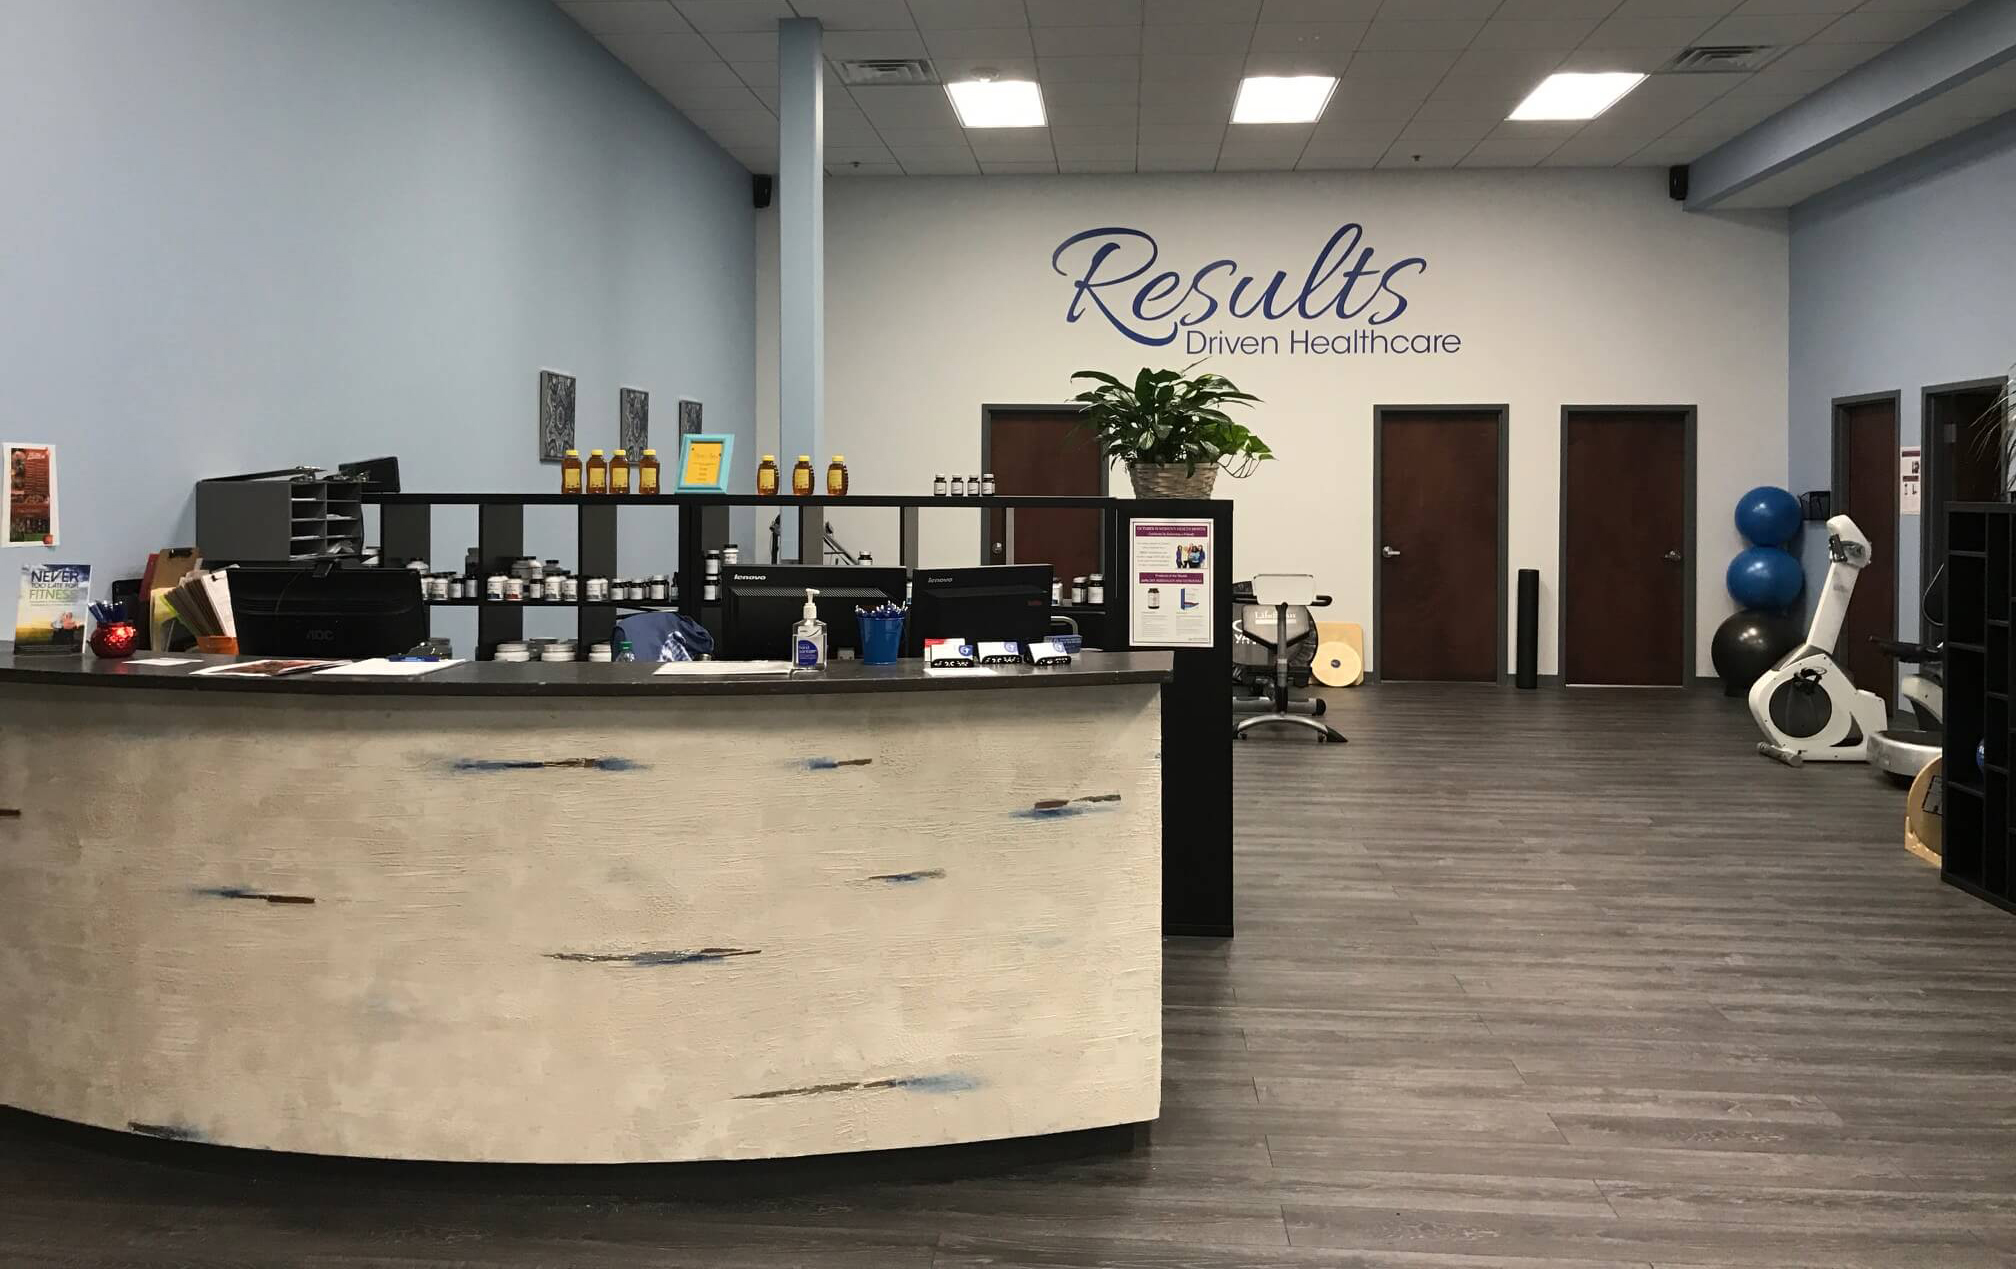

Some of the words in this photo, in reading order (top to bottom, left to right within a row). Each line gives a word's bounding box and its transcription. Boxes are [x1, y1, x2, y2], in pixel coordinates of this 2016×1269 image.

[1052, 223, 1427, 347] Results
[1185, 330, 1279, 355] Driven
[1290, 329, 1461, 355] Healthcare
[31, 570, 79, 582] NEVER
[733, 573, 767, 581] lenovo
